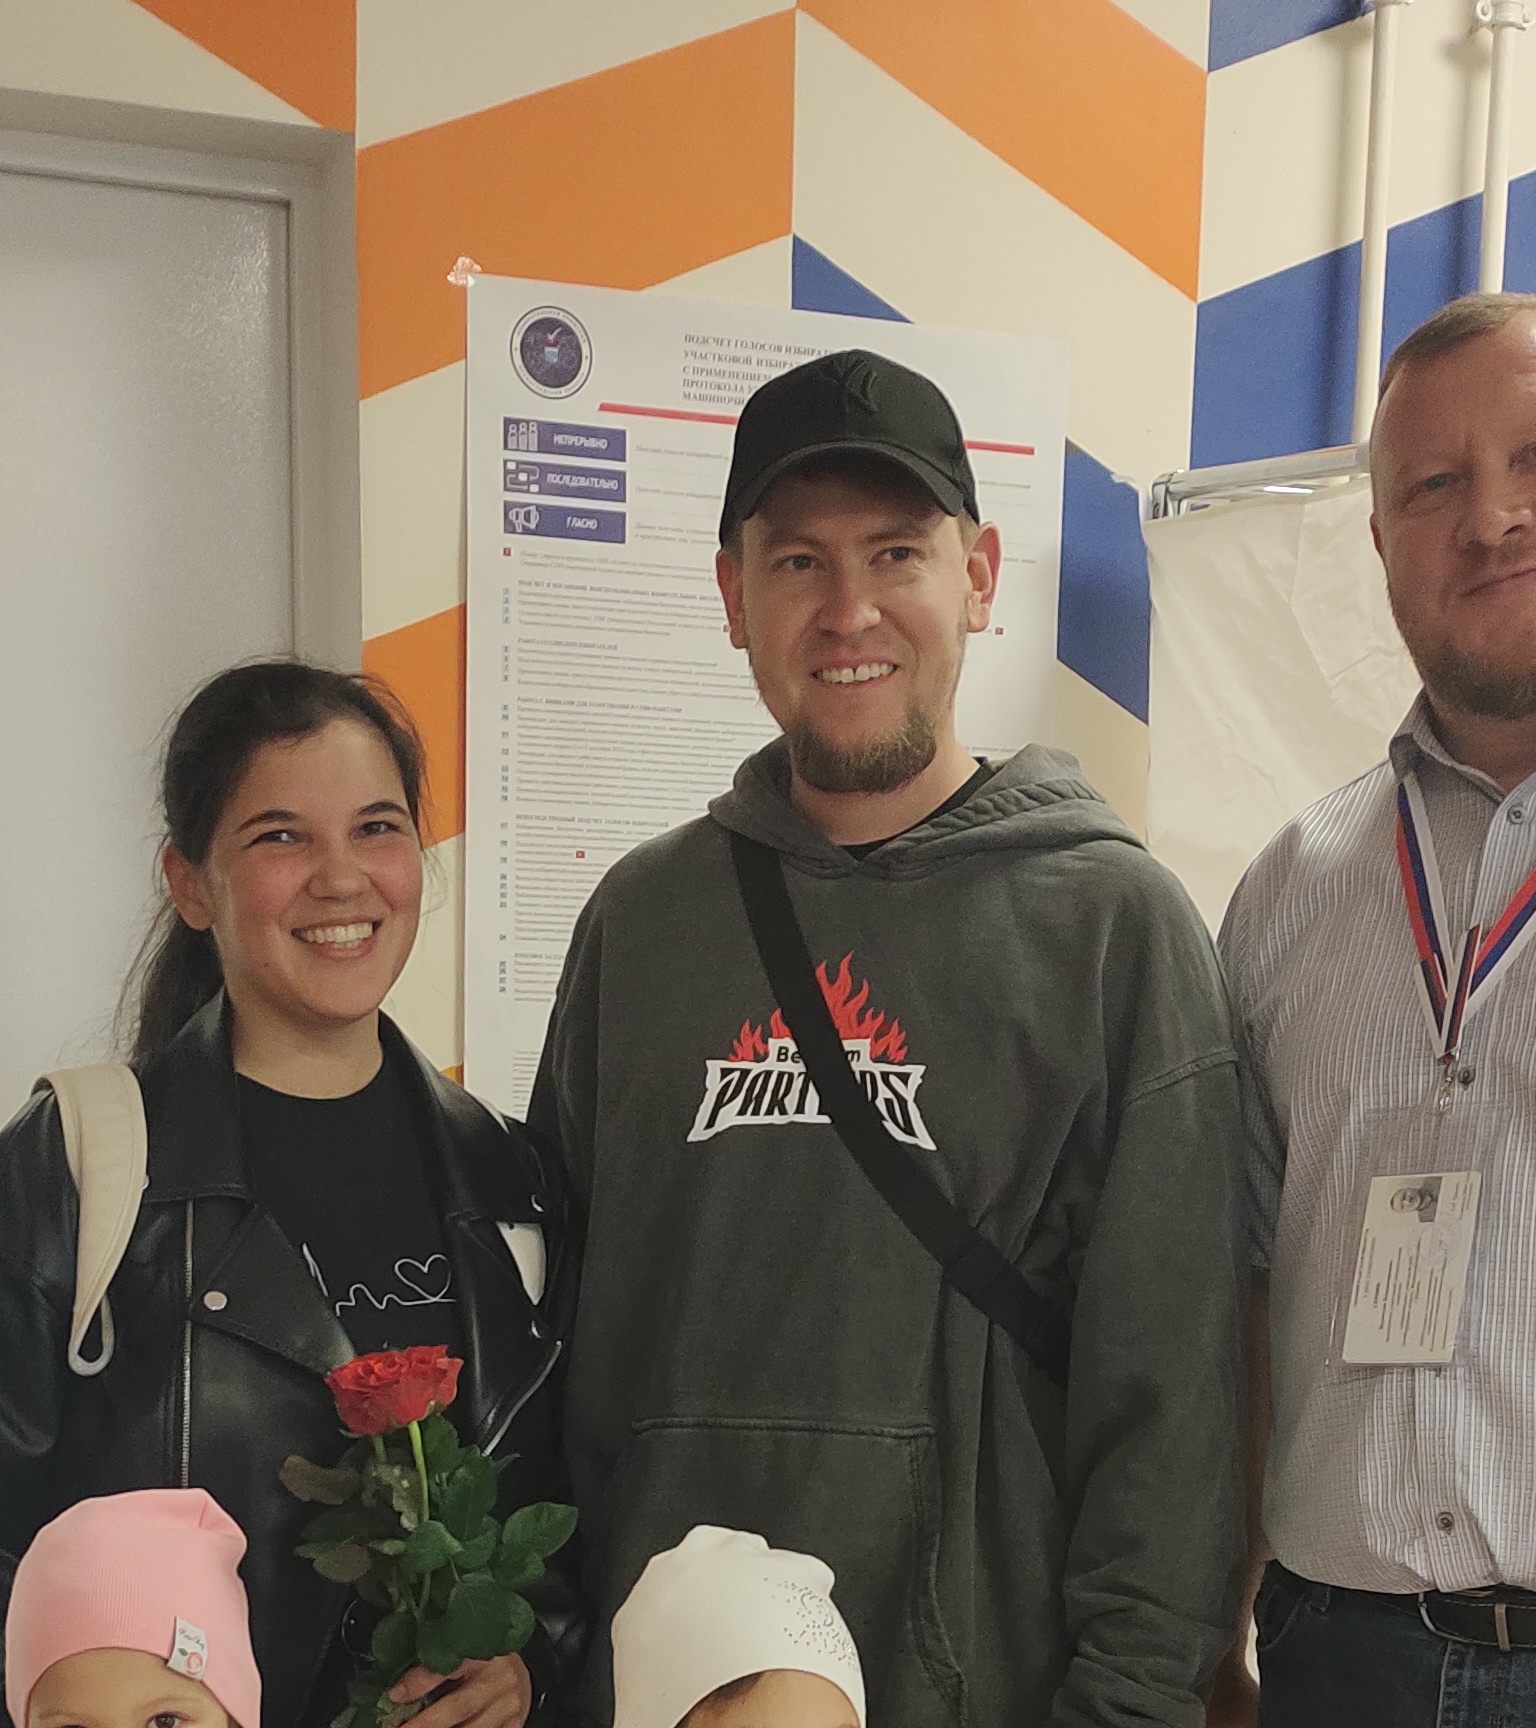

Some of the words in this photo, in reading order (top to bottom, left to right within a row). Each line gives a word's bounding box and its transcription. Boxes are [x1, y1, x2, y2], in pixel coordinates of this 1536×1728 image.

[684, 333, 732, 348] ПОДСЧЕТ
[734, 338, 783, 354] ГОЛОСОВ
[684, 350, 753, 365] УЧАСТКОВОЙ
[682, 378, 745, 392] ПРОТОКОЛА
